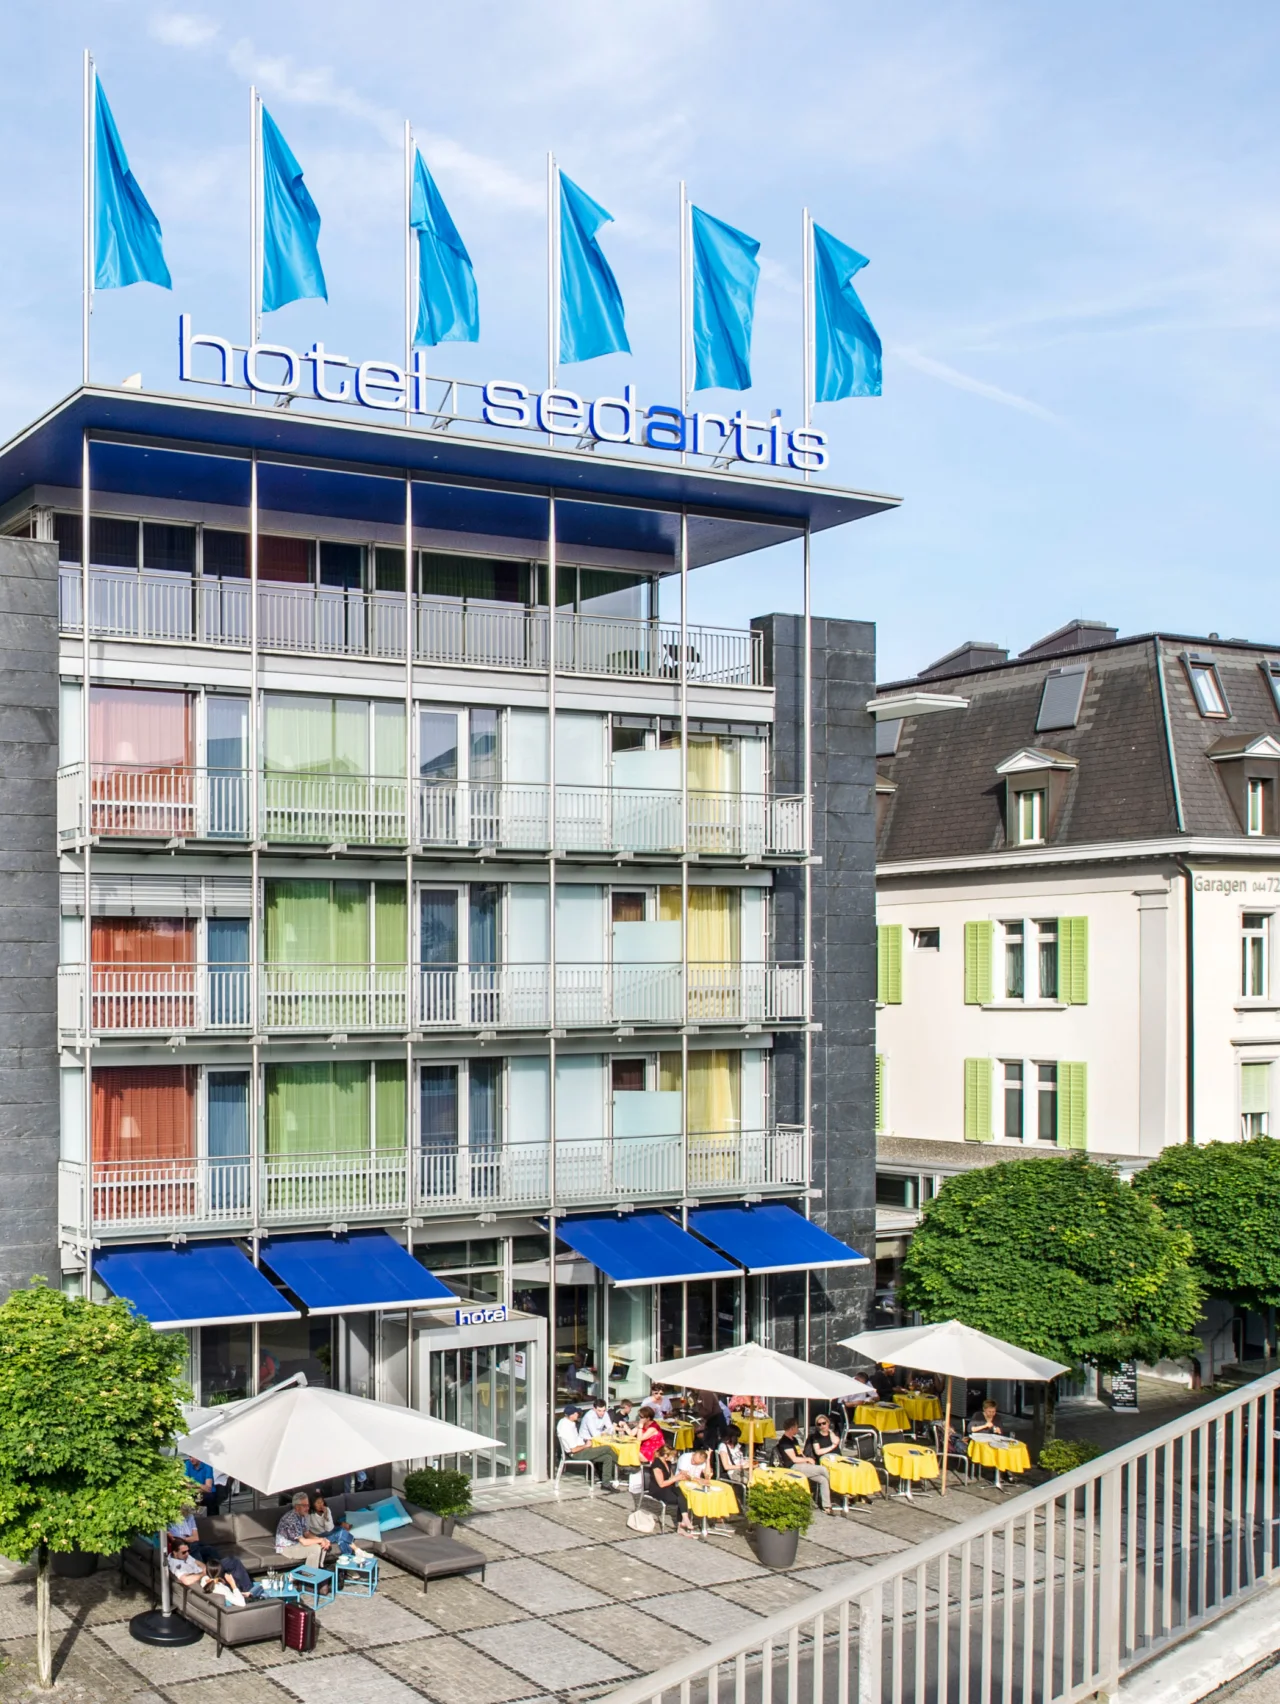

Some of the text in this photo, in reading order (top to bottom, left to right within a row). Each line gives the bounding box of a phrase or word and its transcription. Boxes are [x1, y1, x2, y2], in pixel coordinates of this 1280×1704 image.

[179, 313, 830, 472] hotel sedartis
[1194, 875, 1247, 896] Garagen
[455, 1305, 508, 1326] hotel
